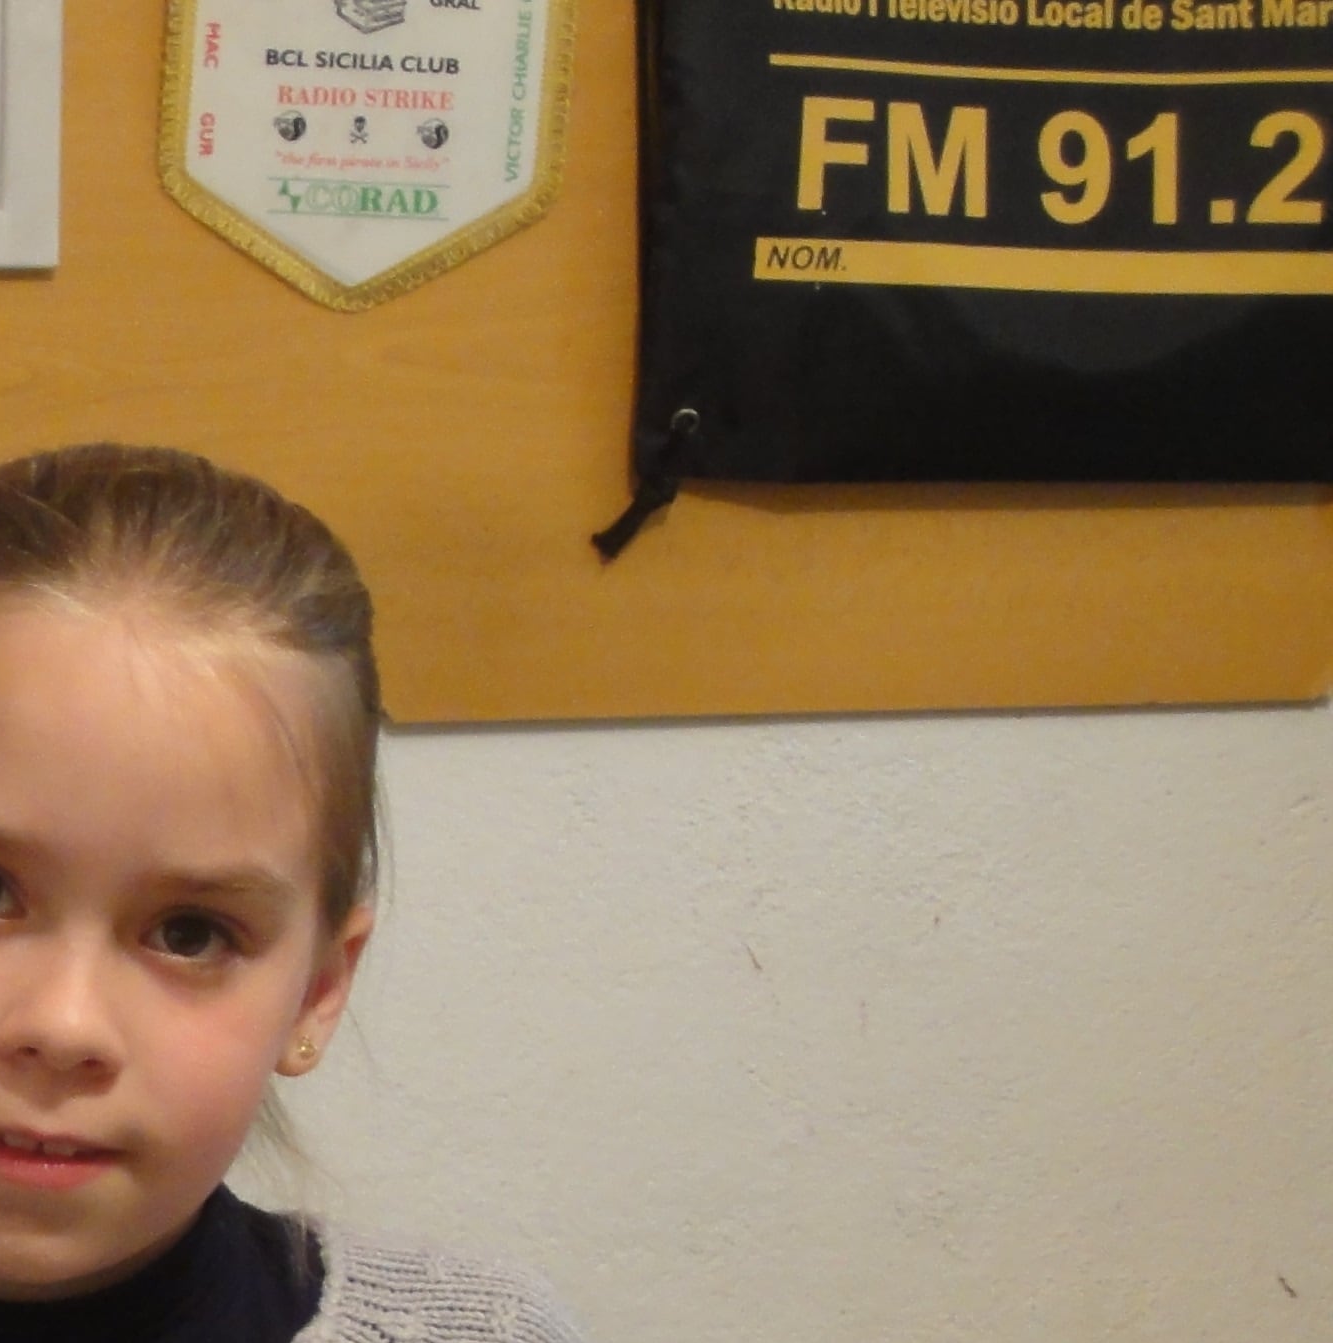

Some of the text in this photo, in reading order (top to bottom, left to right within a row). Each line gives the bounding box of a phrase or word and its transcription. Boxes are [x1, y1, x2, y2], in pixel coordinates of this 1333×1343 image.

[1027, 0, 1114, 29] Local
[1121, 0, 1164, 30] de
[1171, 0, 1253, 30] Sant
[266, 49, 459, 74] BCL SICILIA CLUB
[278, 84, 454, 111] RADIO STRIKE
[505, 107, 525, 182] VICTOR
[797, 96, 1325, 225] FM 91.2
[766, 246, 847, 273] NOM.
